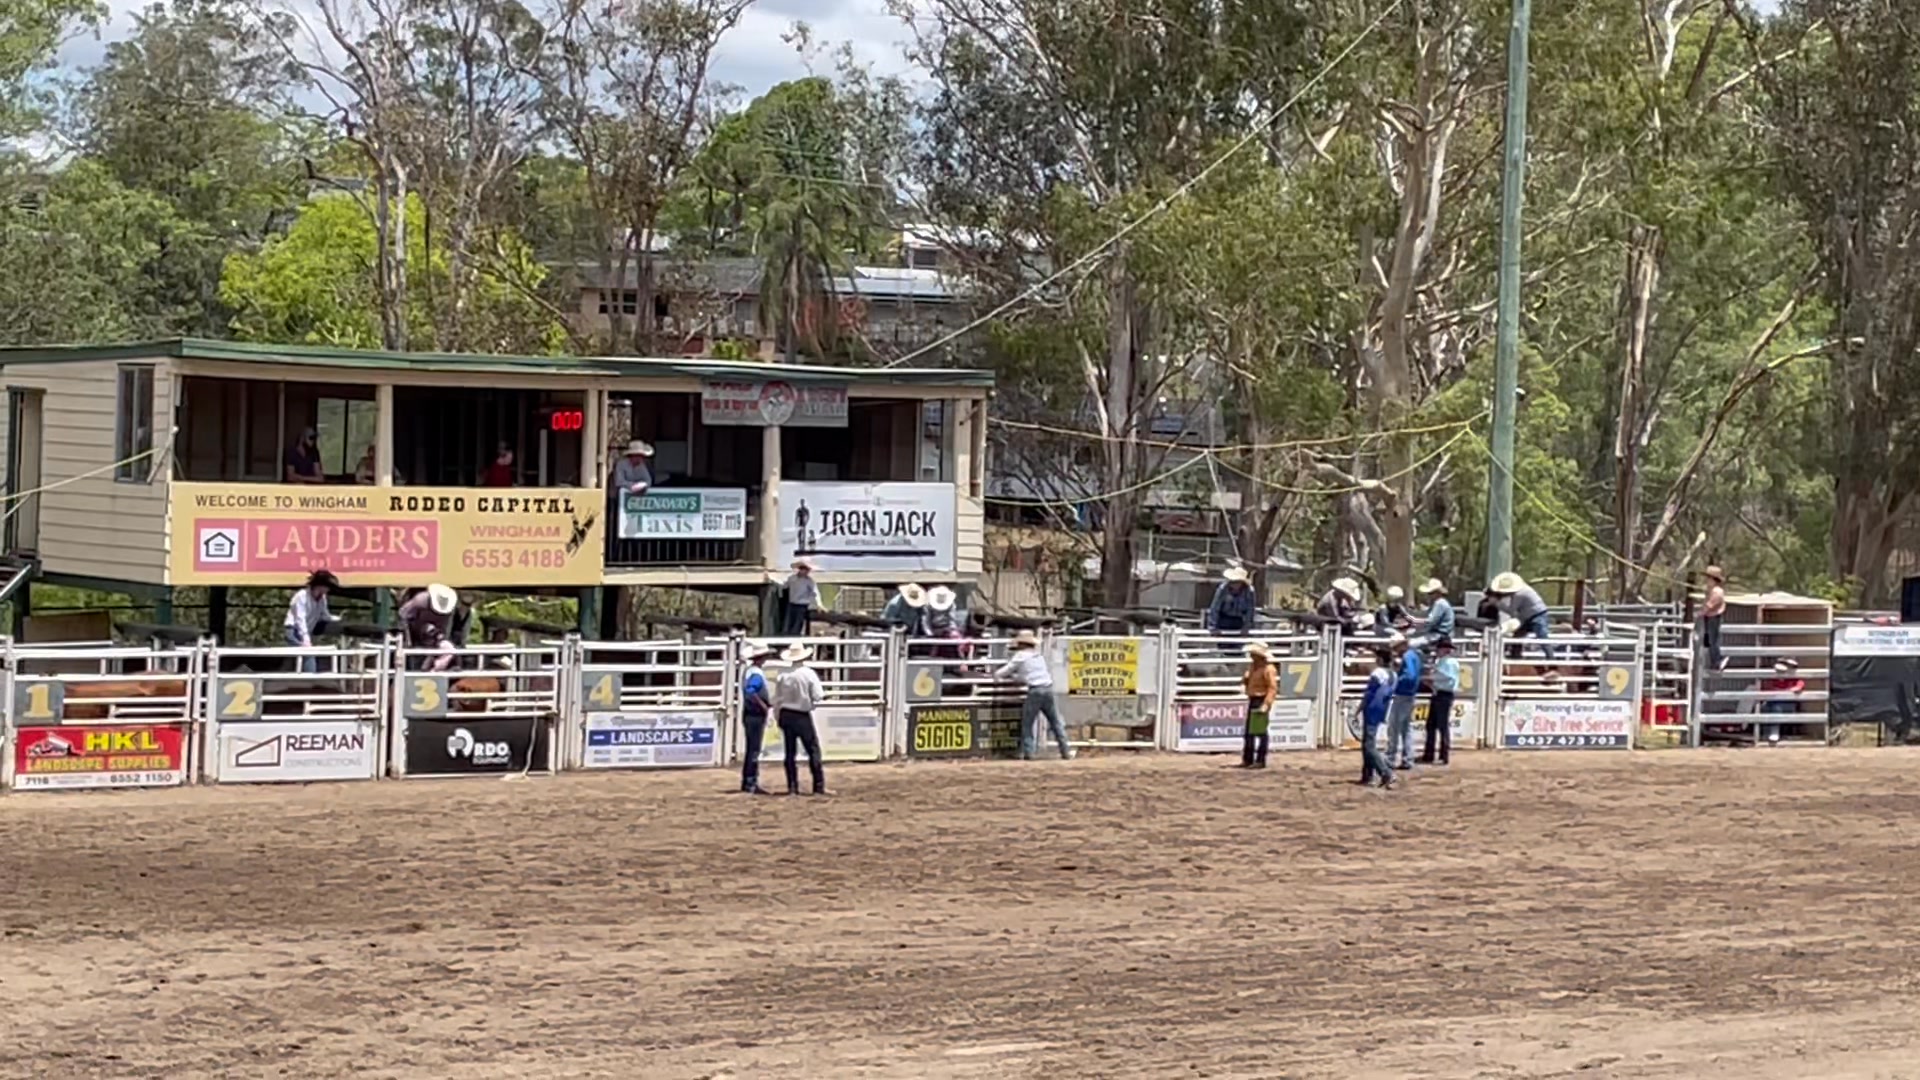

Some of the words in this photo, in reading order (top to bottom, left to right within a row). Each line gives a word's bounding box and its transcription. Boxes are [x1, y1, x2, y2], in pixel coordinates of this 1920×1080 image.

[195, 495, 267, 507] WELCOME
[274, 496, 293, 507] TO
[299, 496, 367, 508] WINGHAM
[389, 496, 465, 512] RODEO
[477, 497, 574, 513] CAPITAL
[470, 525, 561, 537] WINGHAM
[630, 513, 694, 533] Taxis
[820, 510, 876, 537] IRON
[880, 511, 936, 537] JACK
[255, 524, 429, 559] LAUDERS
[300, 557, 331, 568] Real
[342, 557, 386, 569] Estate
[462, 549, 513, 568] 6553
[518, 548, 565, 568] 4188
[1083, 653, 1126, 661] RODEO
[913, 668, 936, 697] 6
[1082, 678, 1125, 687] RODEO
[1288, 665, 1312, 694] 7
[1606, 667, 1629, 696] 9
[223, 682, 257, 716] 2
[411, 679, 440, 711] 3
[589, 675, 615, 706] 4
[23, 685, 54, 717] 1
[917, 709, 970, 721] MANNING
[1193, 726, 1244, 736] AGENCIE
[1560, 716, 1582, 732] Tree
[1585, 716, 1623, 732] Service
[86, 731, 160, 751] HKL
[286, 734, 364, 751] REEMAN
[611, 731, 693, 743] LANDSCAPES
[1517, 736, 1553, 745] 0437
[1558, 736, 1585, 745] 473
[475, 742, 509, 756] RDO
